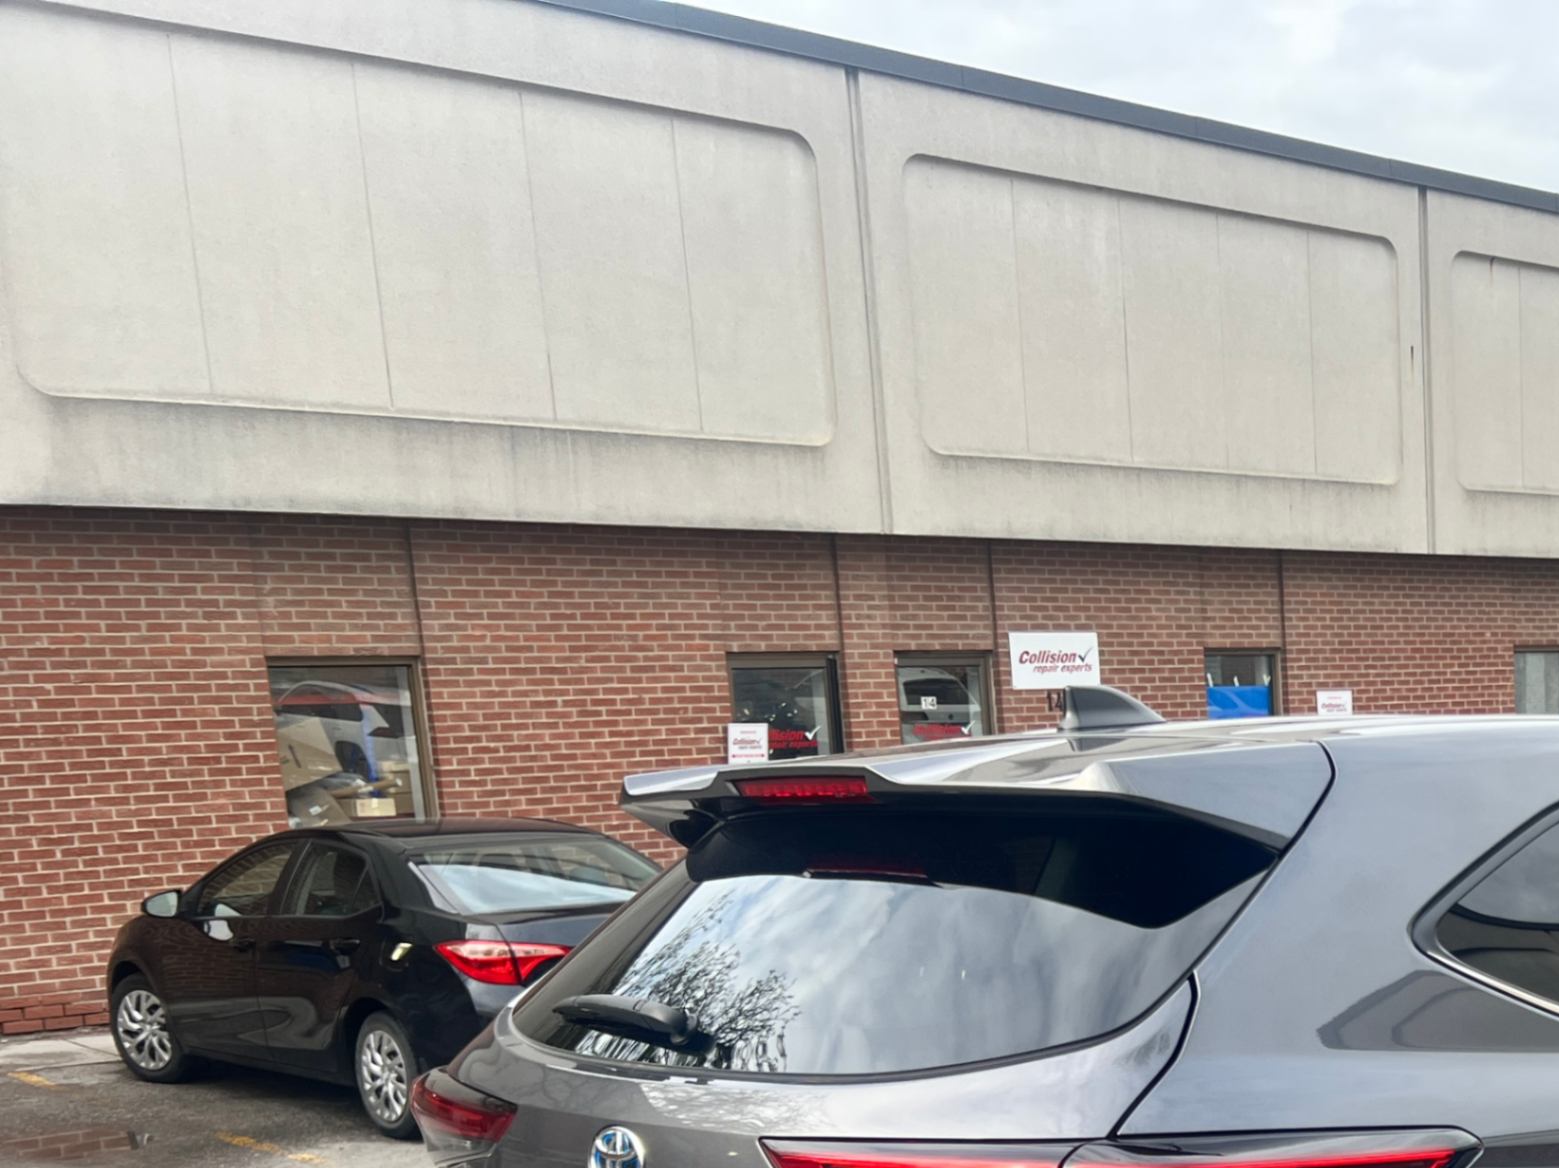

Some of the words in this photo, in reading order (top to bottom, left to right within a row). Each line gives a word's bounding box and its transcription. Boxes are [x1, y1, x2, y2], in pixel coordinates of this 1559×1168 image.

[1018, 650, 1077, 665] Collision
[1033, 664, 1059, 674] repair
[1060, 663, 1092, 674] experts
